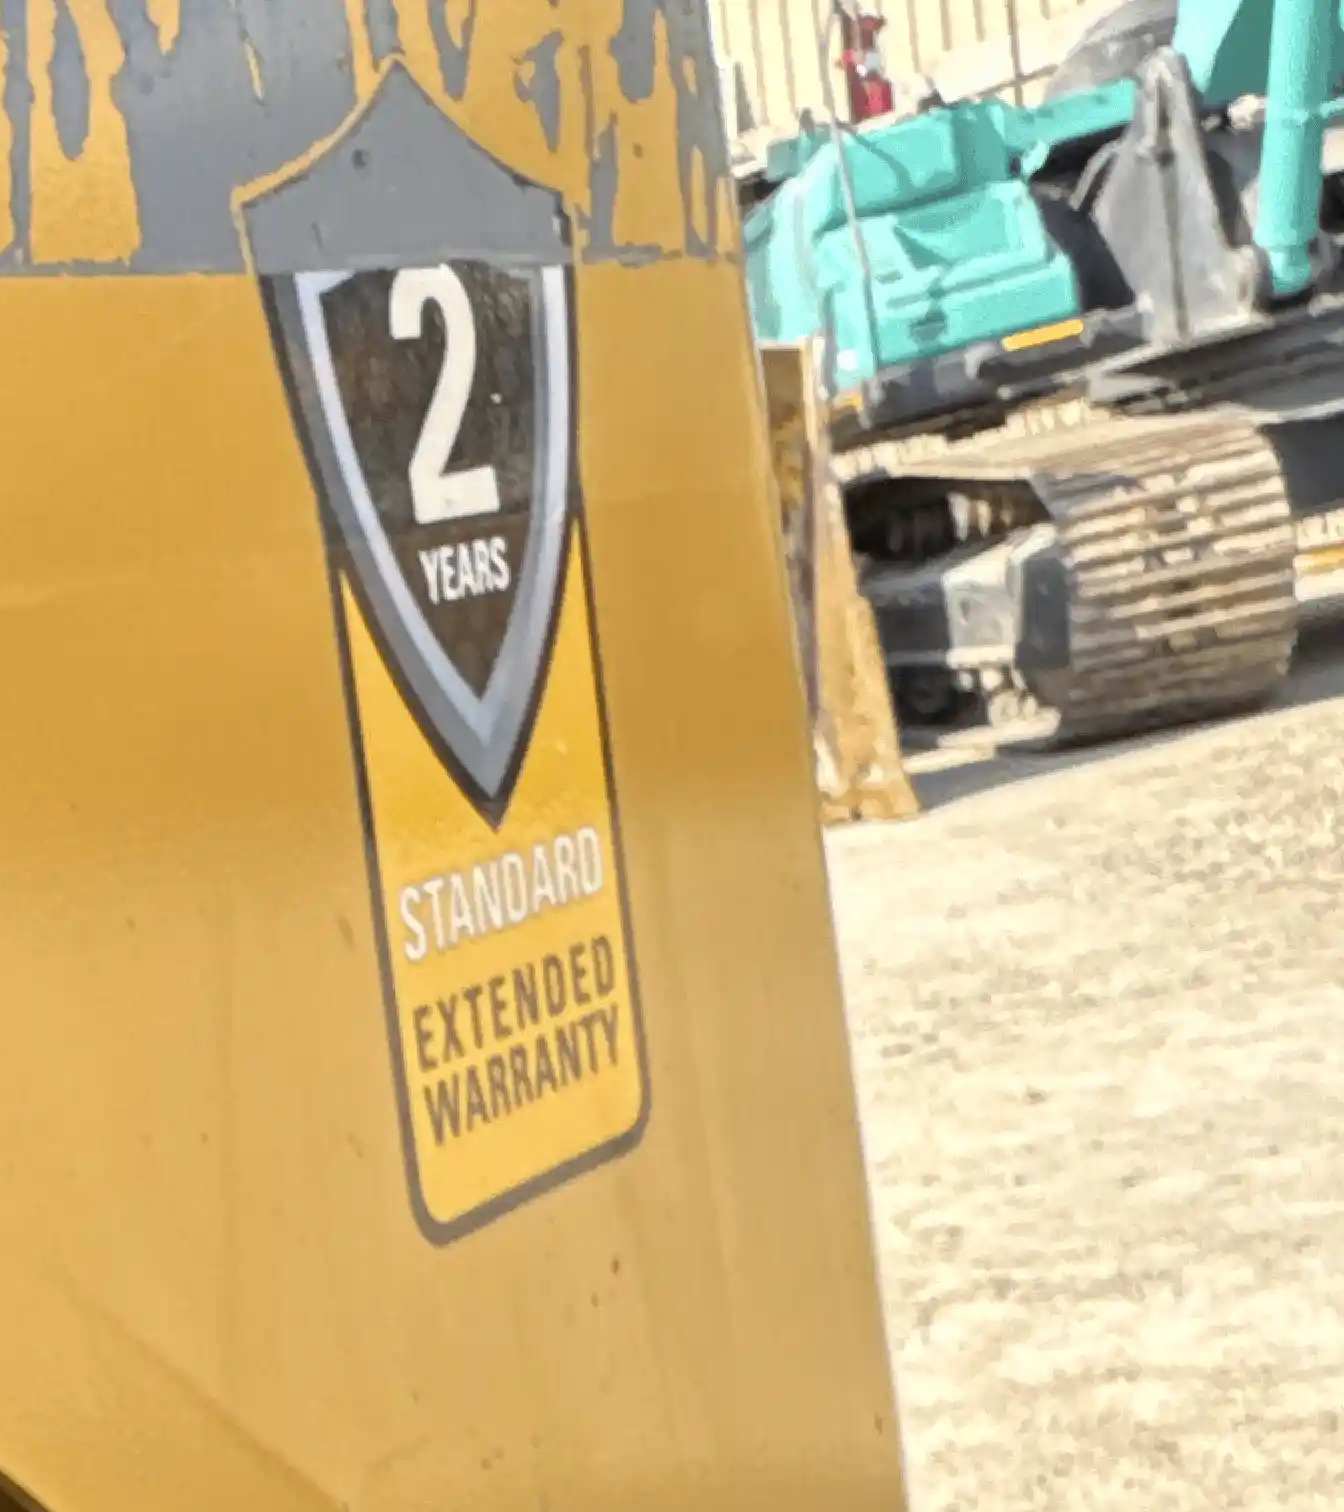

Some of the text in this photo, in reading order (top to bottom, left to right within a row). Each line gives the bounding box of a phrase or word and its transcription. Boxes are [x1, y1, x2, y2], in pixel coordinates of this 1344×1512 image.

[389, 263, 500, 524] 2
[418, 537, 511, 604] YEARS
[398, 825, 605, 962] STANDARD
[413, 934, 615, 1072] EXTENDED
[423, 1004, 620, 1147] WARRANTY
